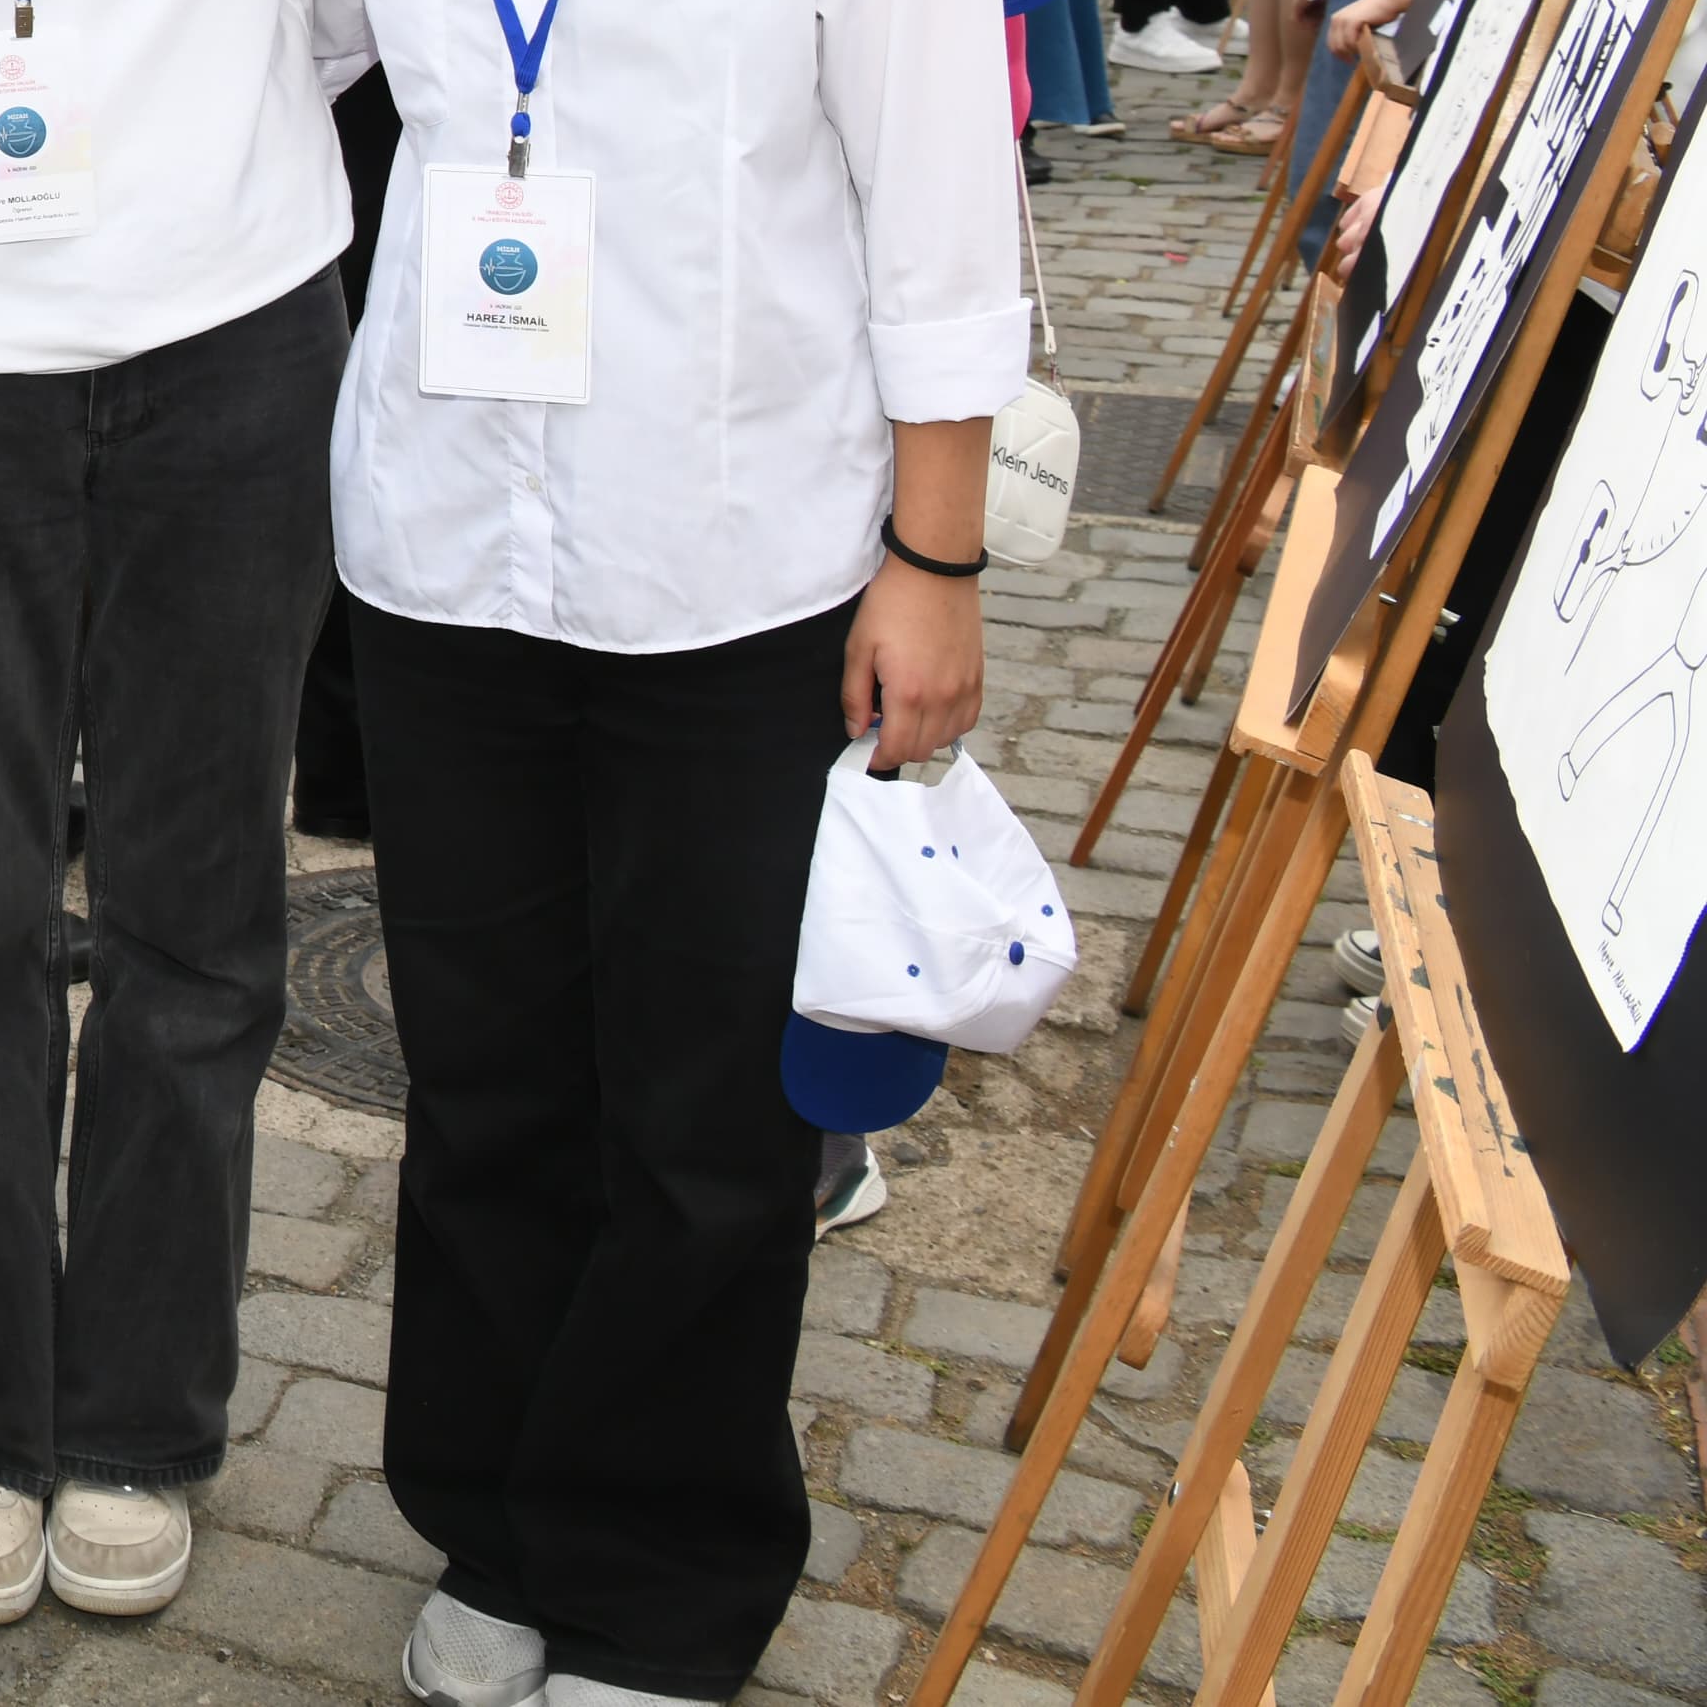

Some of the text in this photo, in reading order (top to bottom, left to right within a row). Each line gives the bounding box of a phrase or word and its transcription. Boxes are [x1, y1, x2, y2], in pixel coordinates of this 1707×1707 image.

[466, 312, 548, 327] HAREZ İSMAİL
[992, 443, 1068, 495] Klein Jeans
